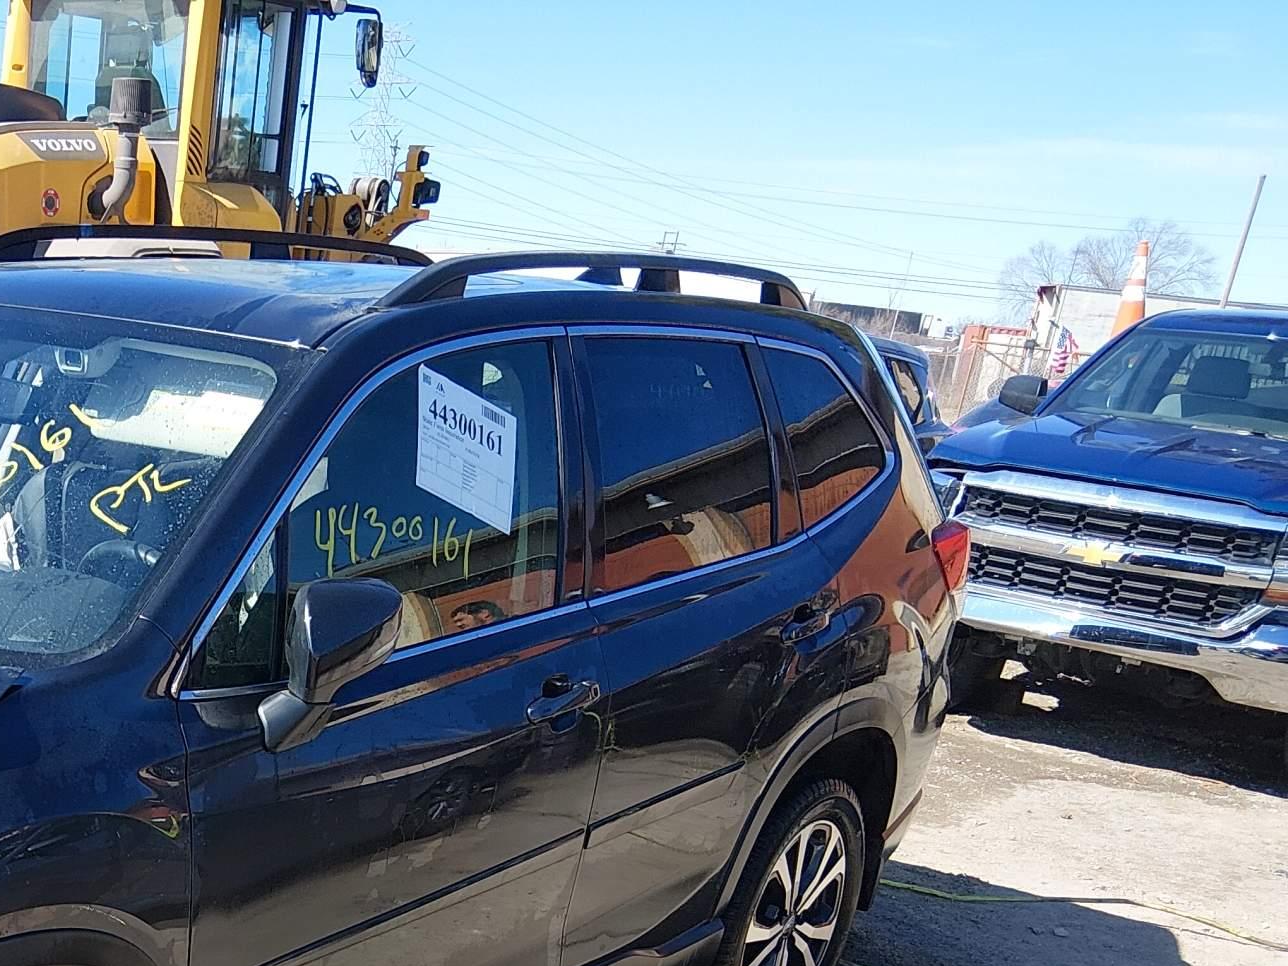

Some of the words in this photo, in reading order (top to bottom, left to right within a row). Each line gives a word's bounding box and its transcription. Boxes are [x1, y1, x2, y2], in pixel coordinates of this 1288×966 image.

[30, 138, 97, 152] VOLVO
[428, 399, 503, 456] 44300161
[315, 502, 473, 580] 44300161
